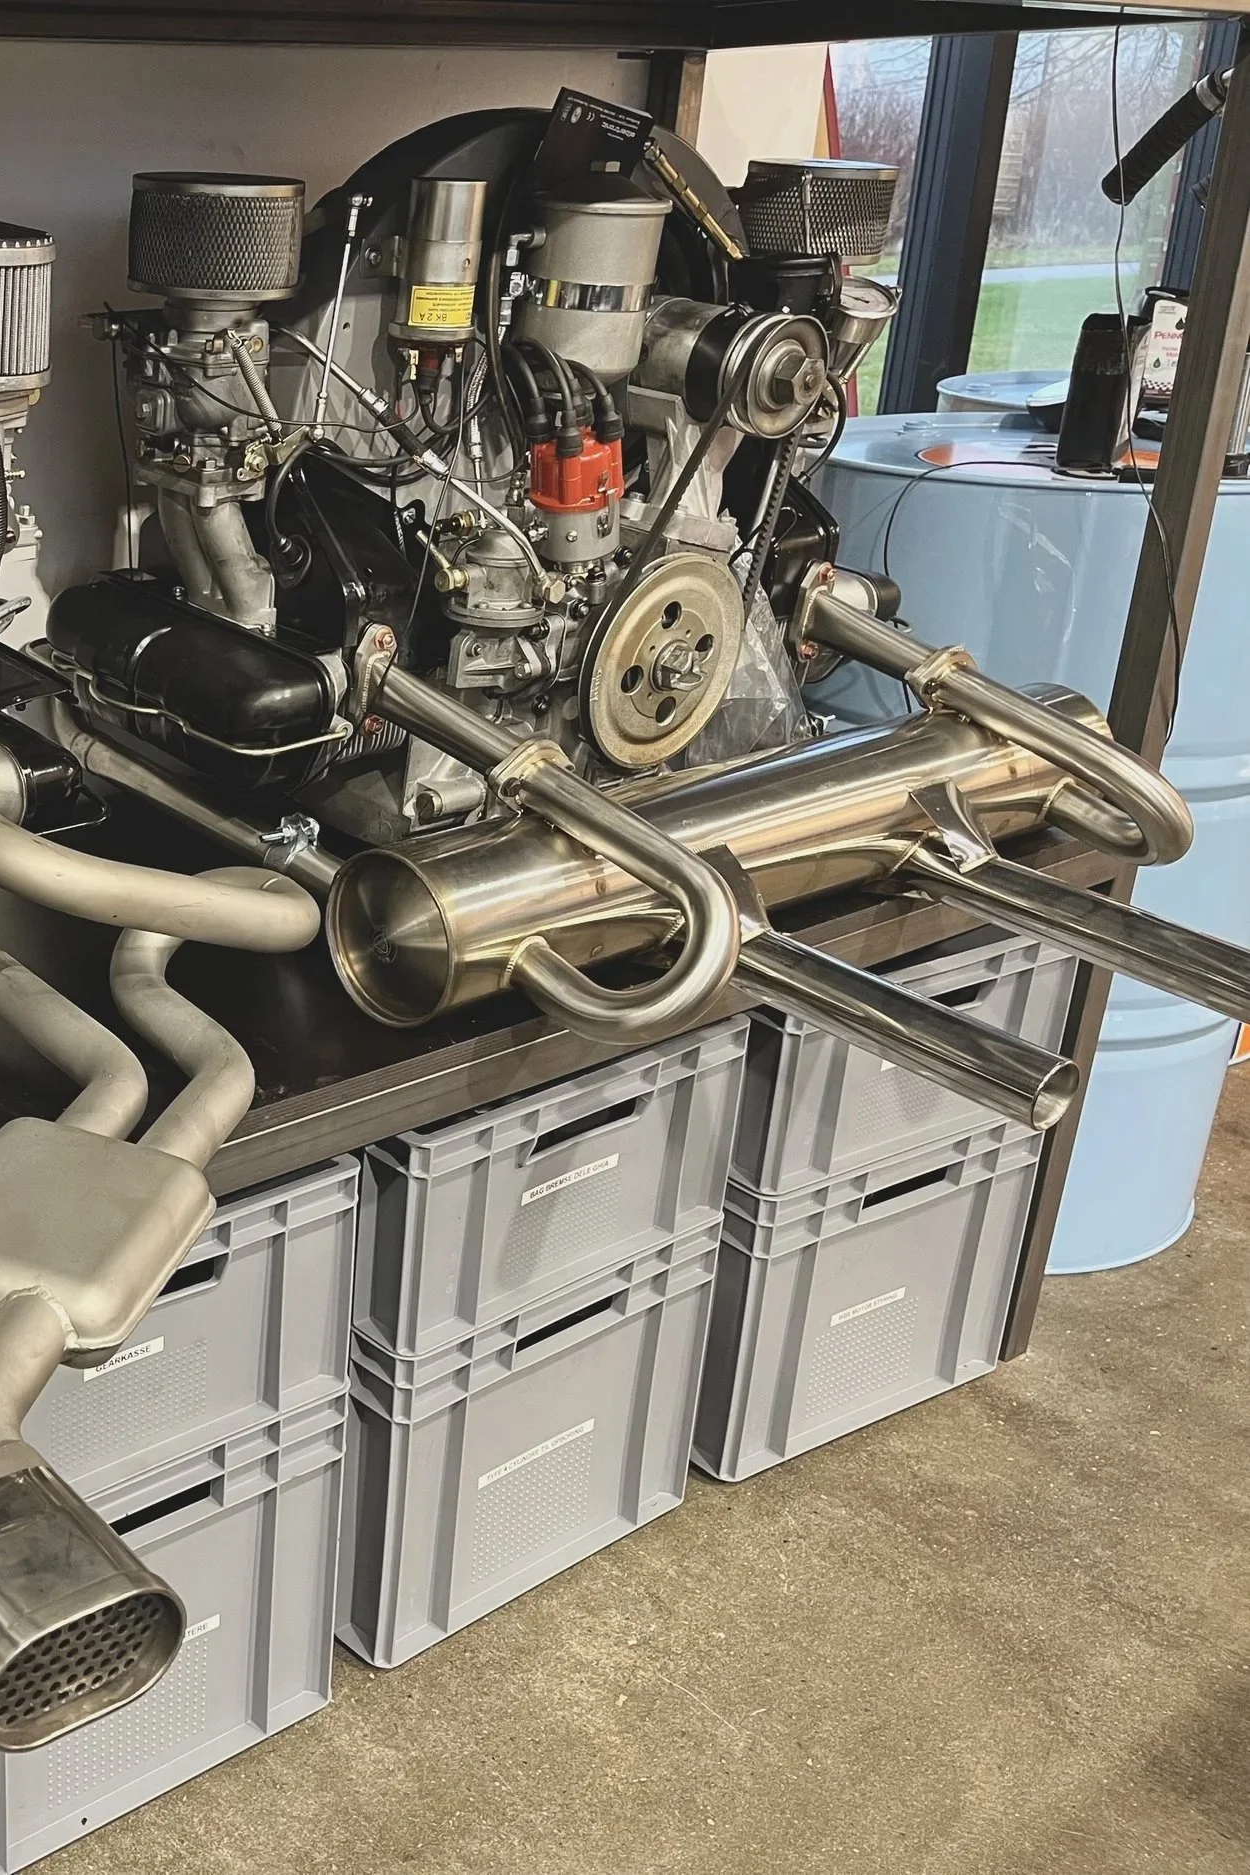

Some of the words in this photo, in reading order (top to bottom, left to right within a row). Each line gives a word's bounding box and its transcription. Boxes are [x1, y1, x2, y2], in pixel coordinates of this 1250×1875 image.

[529, 1187, 545, 1199] BAG
[545, 1174, 572, 1192] BREMSE
[95, 1344, 151, 1373] GEARKASSE
[187, 1622, 208, 1637] TERE
